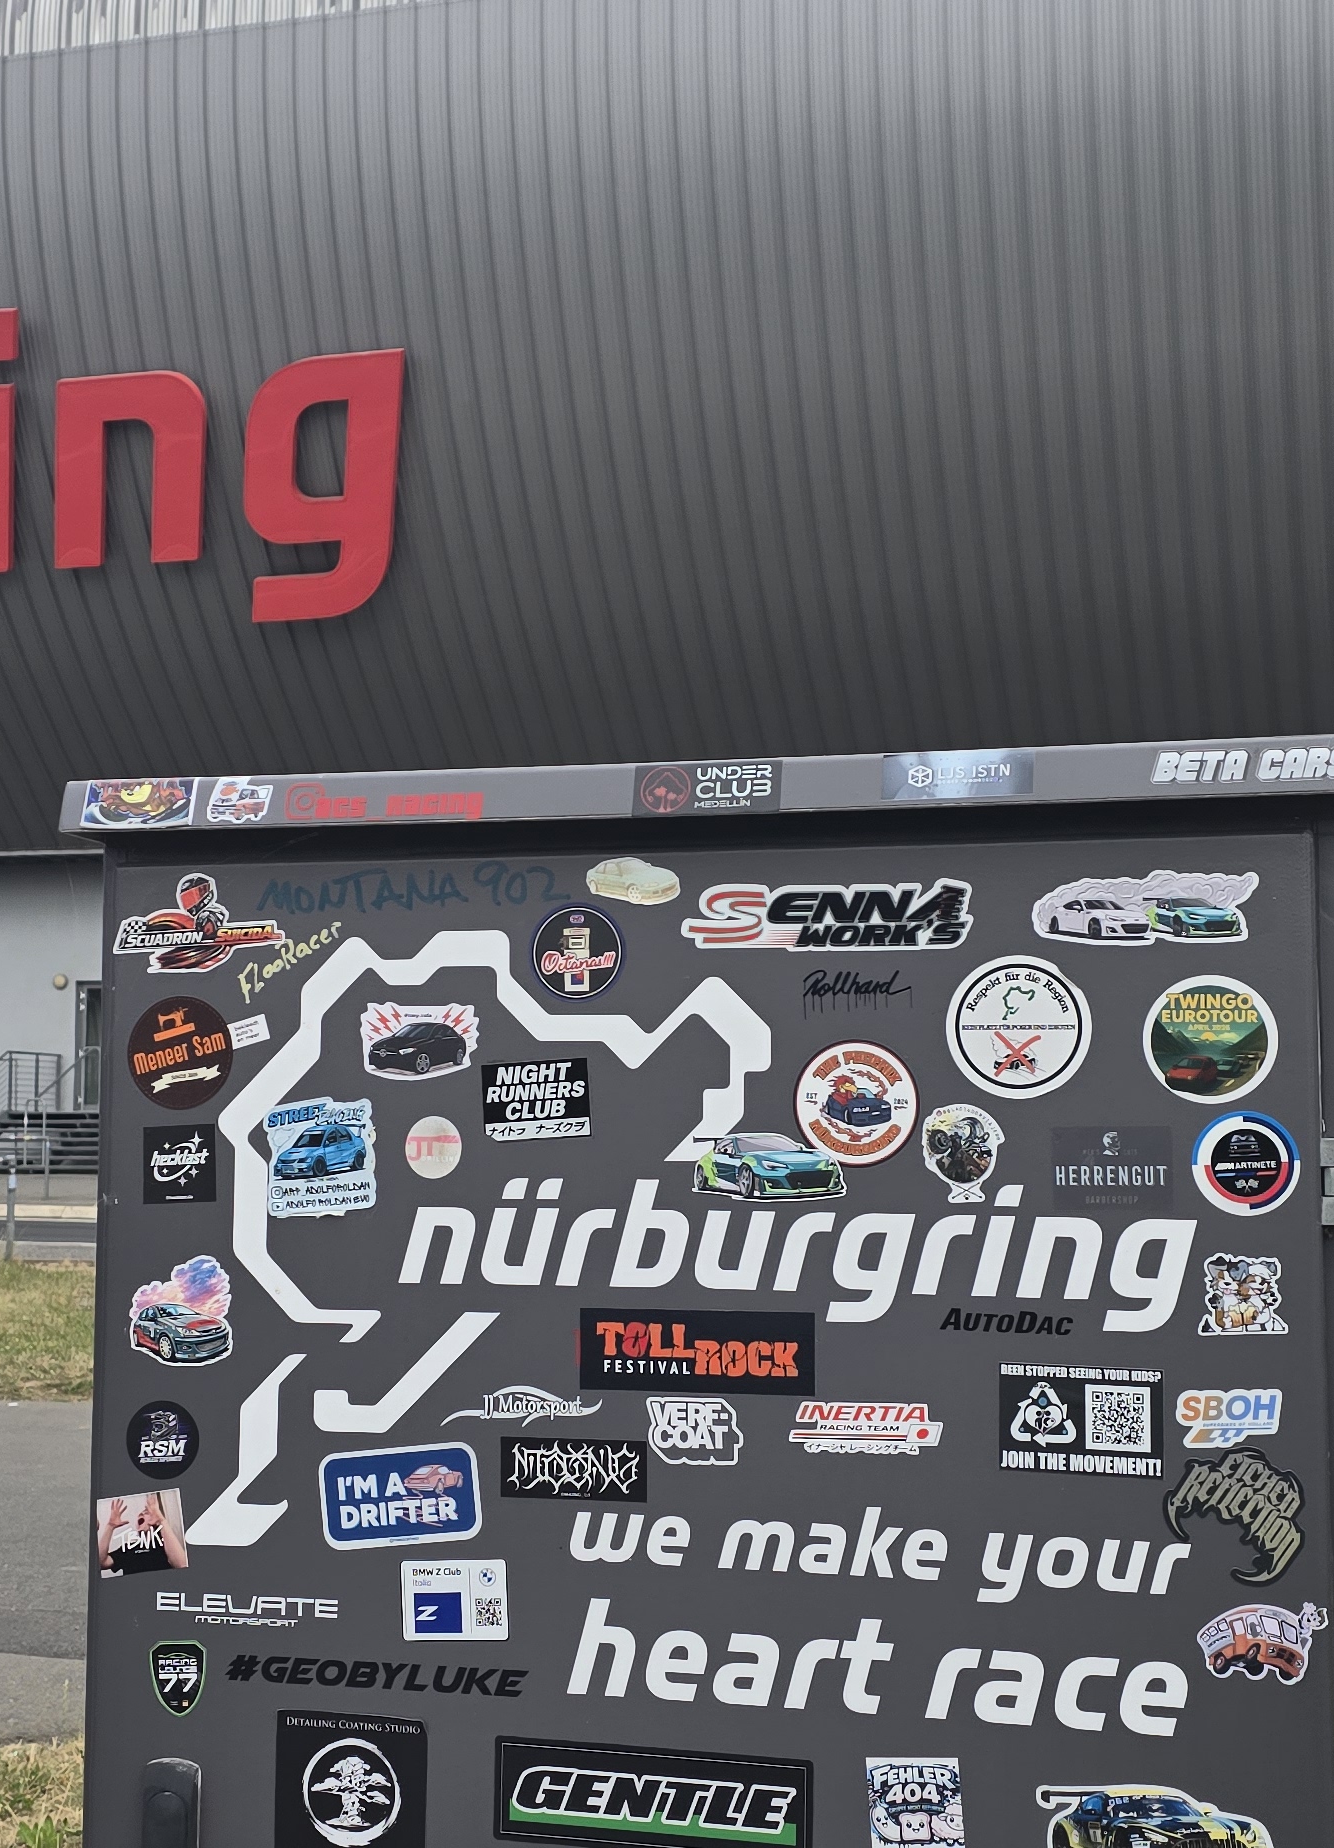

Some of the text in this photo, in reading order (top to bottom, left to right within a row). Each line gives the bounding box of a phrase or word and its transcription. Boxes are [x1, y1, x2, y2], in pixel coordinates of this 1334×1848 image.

[696, 764, 773, 780] UNDER
[1151, 749, 1251, 784] BETA
[695, 779, 773, 799] CLUB
[256, 860, 572, 915] MONTANA 902
[124, 931, 204, 948] SCUADRON
[793, 919, 968, 948] WORK'S
[966, 976, 1002, 1012] Respekt
[1024, 972, 1041, 984] die
[1043, 978, 1069, 1013] Region
[1166, 993, 1253, 1009] TWINGO
[1161, 1009, 1258, 1023] EUROTOUR
[133, 1032, 226, 1075] Meneer Sam
[495, 1062, 572, 1085] NIGHT
[486, 1080, 586, 1103] RUNNERS
[505, 1100, 566, 1120] CLUB
[1055, 1165, 1168, 1186] HERRENGUT
[398, 1177, 1198, 1333] nürburgring
[603, 1359, 691, 1375] FESTIVAL
[1000, 1363, 1162, 1382] BEEN STOPPED SEEING YOUR KIDS?
[498, 1394, 583, 1421] Motorsport
[798, 1404, 926, 1422] INERTIA
[1181, 1395, 1277, 1421] SBOH
[653, 1425, 729, 1449] COAT
[867, 1424, 900, 1432] TEAM
[138, 1440, 187, 1457] RSM
[1000, 1450, 1162, 1477] JOIN THE MOVEMENT!
[337, 1472, 408, 1500] I'M A
[339, 1497, 459, 1529] DRIFTER
[569, 1506, 1192, 1604] we make your
[412, 1567, 462, 1576] BMW Z Club
[156, 1591, 339, 1618] ELEVATE
[195, 1615, 298, 1627] MOTORSPORT
[225, 1654, 530, 1697] #GEOBYLUKE
[566, 1597, 1189, 1737] heart race
[158, 1673, 198, 1693] 77
[286, 1716, 421, 1735] DETAILING COATING STUDIO
[871, 1764, 956, 1791] FEHLER
[513, 1765, 797, 1834] GENTLE
[885, 1783, 941, 1804] 404
